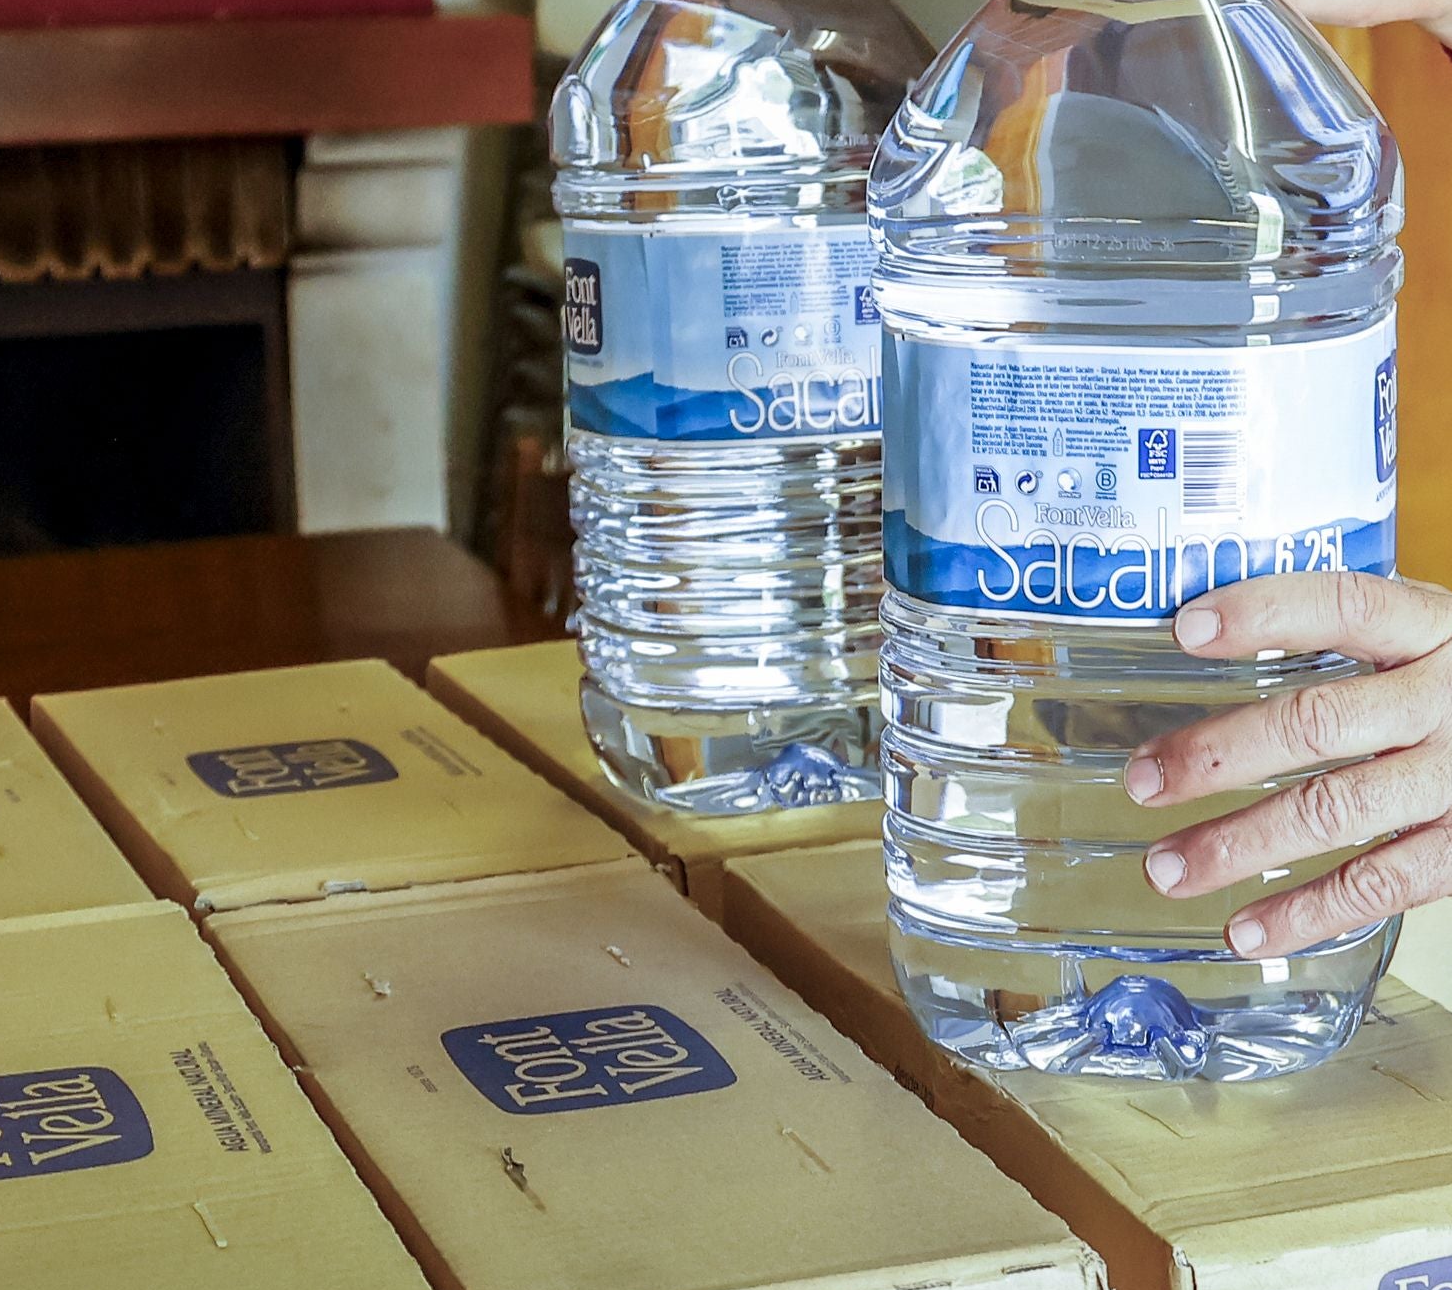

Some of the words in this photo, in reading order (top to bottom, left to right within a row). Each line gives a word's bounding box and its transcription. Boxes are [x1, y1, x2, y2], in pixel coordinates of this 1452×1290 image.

[564, 305, 599, 345] Vella
[726, 346, 880, 433] Sacal
[975, 499, 1247, 611] Sacalm
[1275, 526, 1348, 574] 625L
[478, 1025, 609, 1107] Font
[568, 1010, 704, 1095] Vella
[789, 1056, 830, 1080] AGUA
[192, 1085, 233, 1124] MINERAL
[214, 1124, 248, 1151] AGUA
